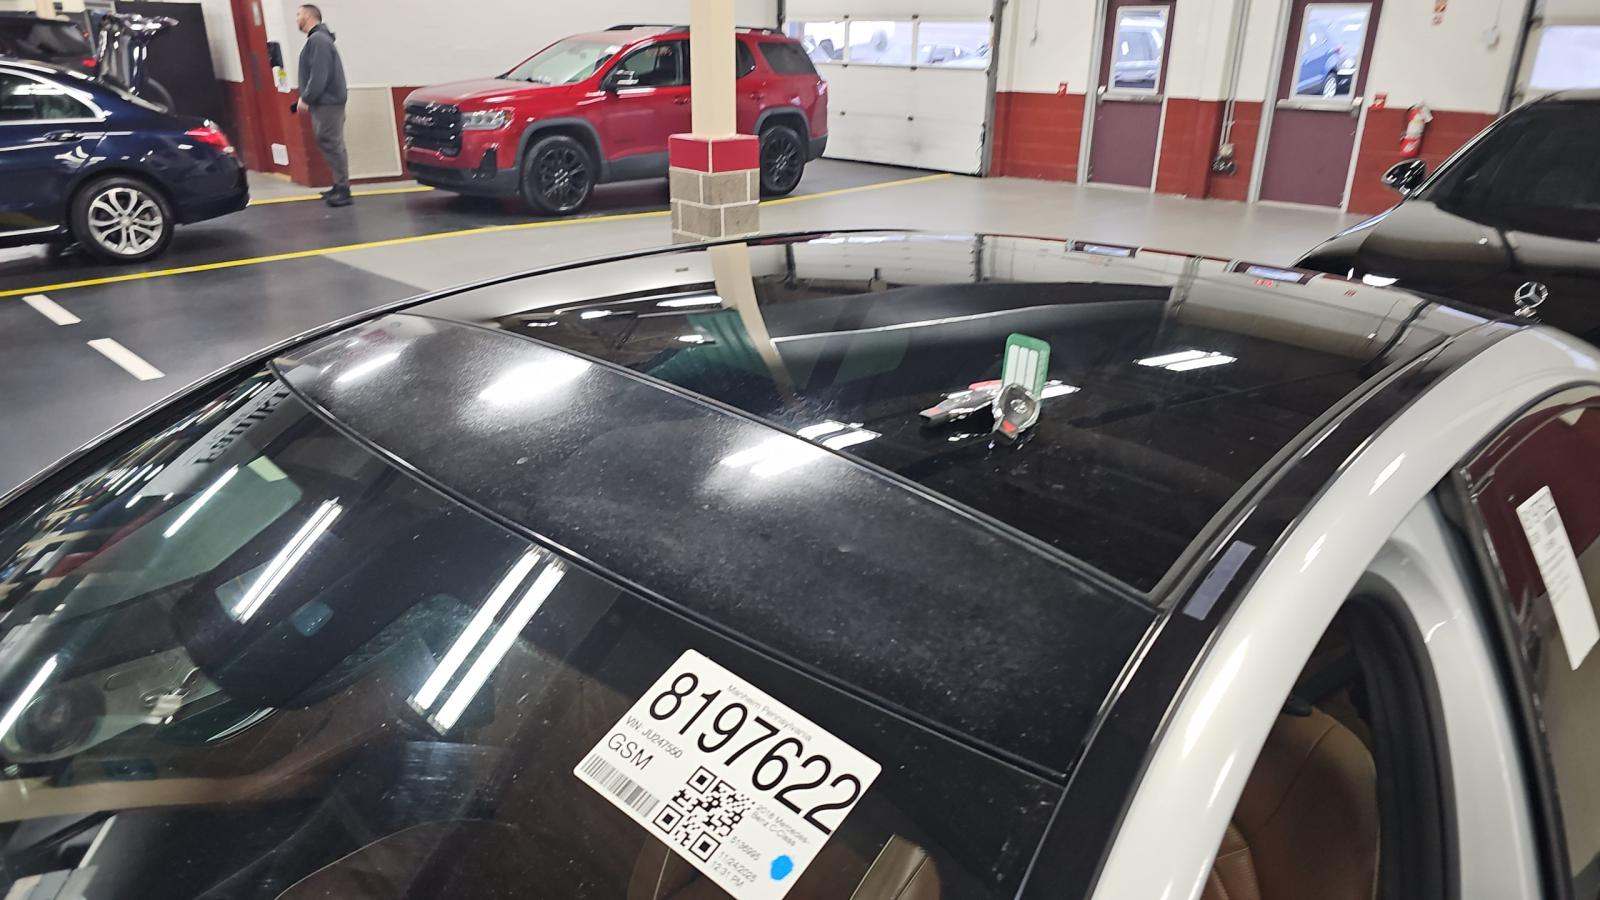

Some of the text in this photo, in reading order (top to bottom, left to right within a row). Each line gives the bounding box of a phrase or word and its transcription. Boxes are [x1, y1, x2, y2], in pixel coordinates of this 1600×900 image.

[608, 733, 654, 770] GSM
[641, 728, 684, 759] JU247550
[649, 672, 862, 836] 8197622
